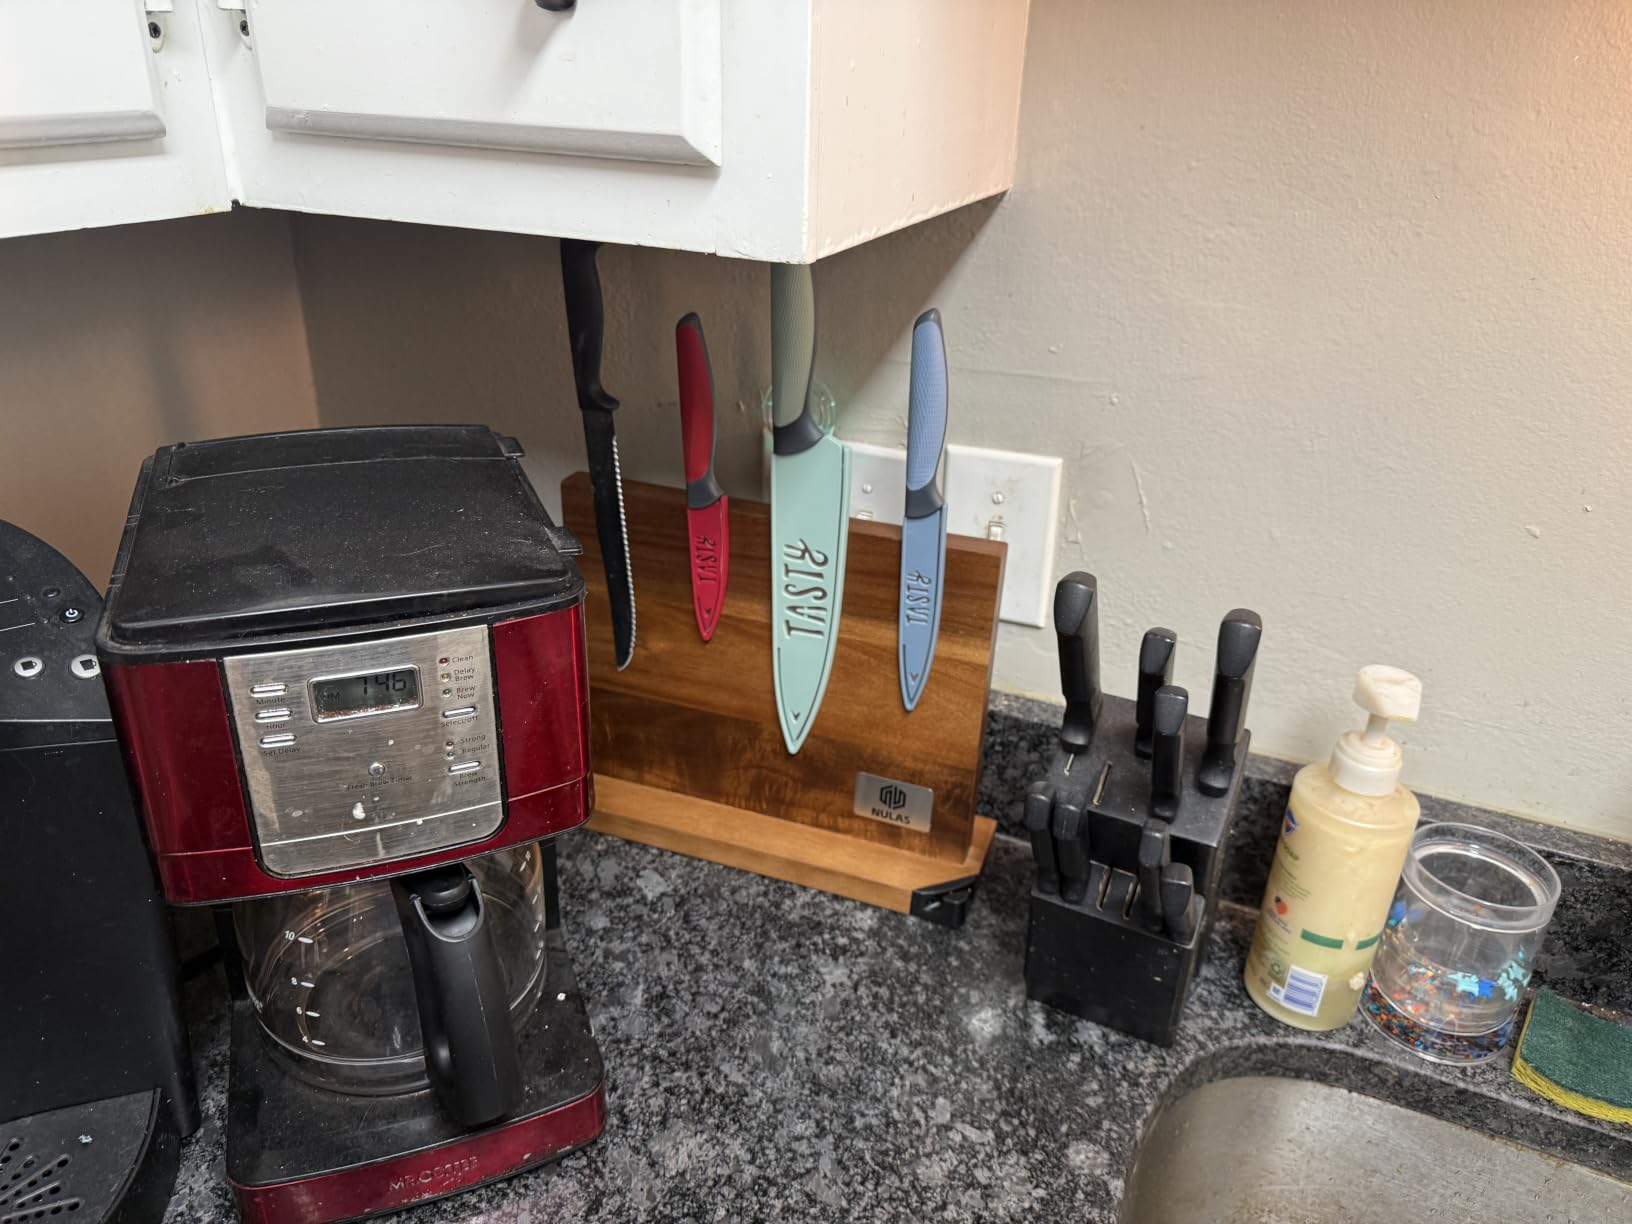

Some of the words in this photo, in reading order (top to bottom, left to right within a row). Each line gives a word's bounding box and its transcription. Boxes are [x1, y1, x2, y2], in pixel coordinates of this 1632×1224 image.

[695, 535, 717, 583] TASTY
[783, 538, 829, 639] TASTY
[905, 570, 931, 625] TASTY
[452, 655, 474, 663] Clean
[453, 666, 476, 675] Delay
[455, 674, 474, 682] Brew
[456, 686, 476, 694] Brew
[457, 692, 475, 700] Now
[460, 734, 486, 744] Strong
[462, 743, 490, 754] Regular
[872, 807, 911, 825] NULAS
[284, 930, 295, 941] 10
[296, 1006, 303, 1015] 6
